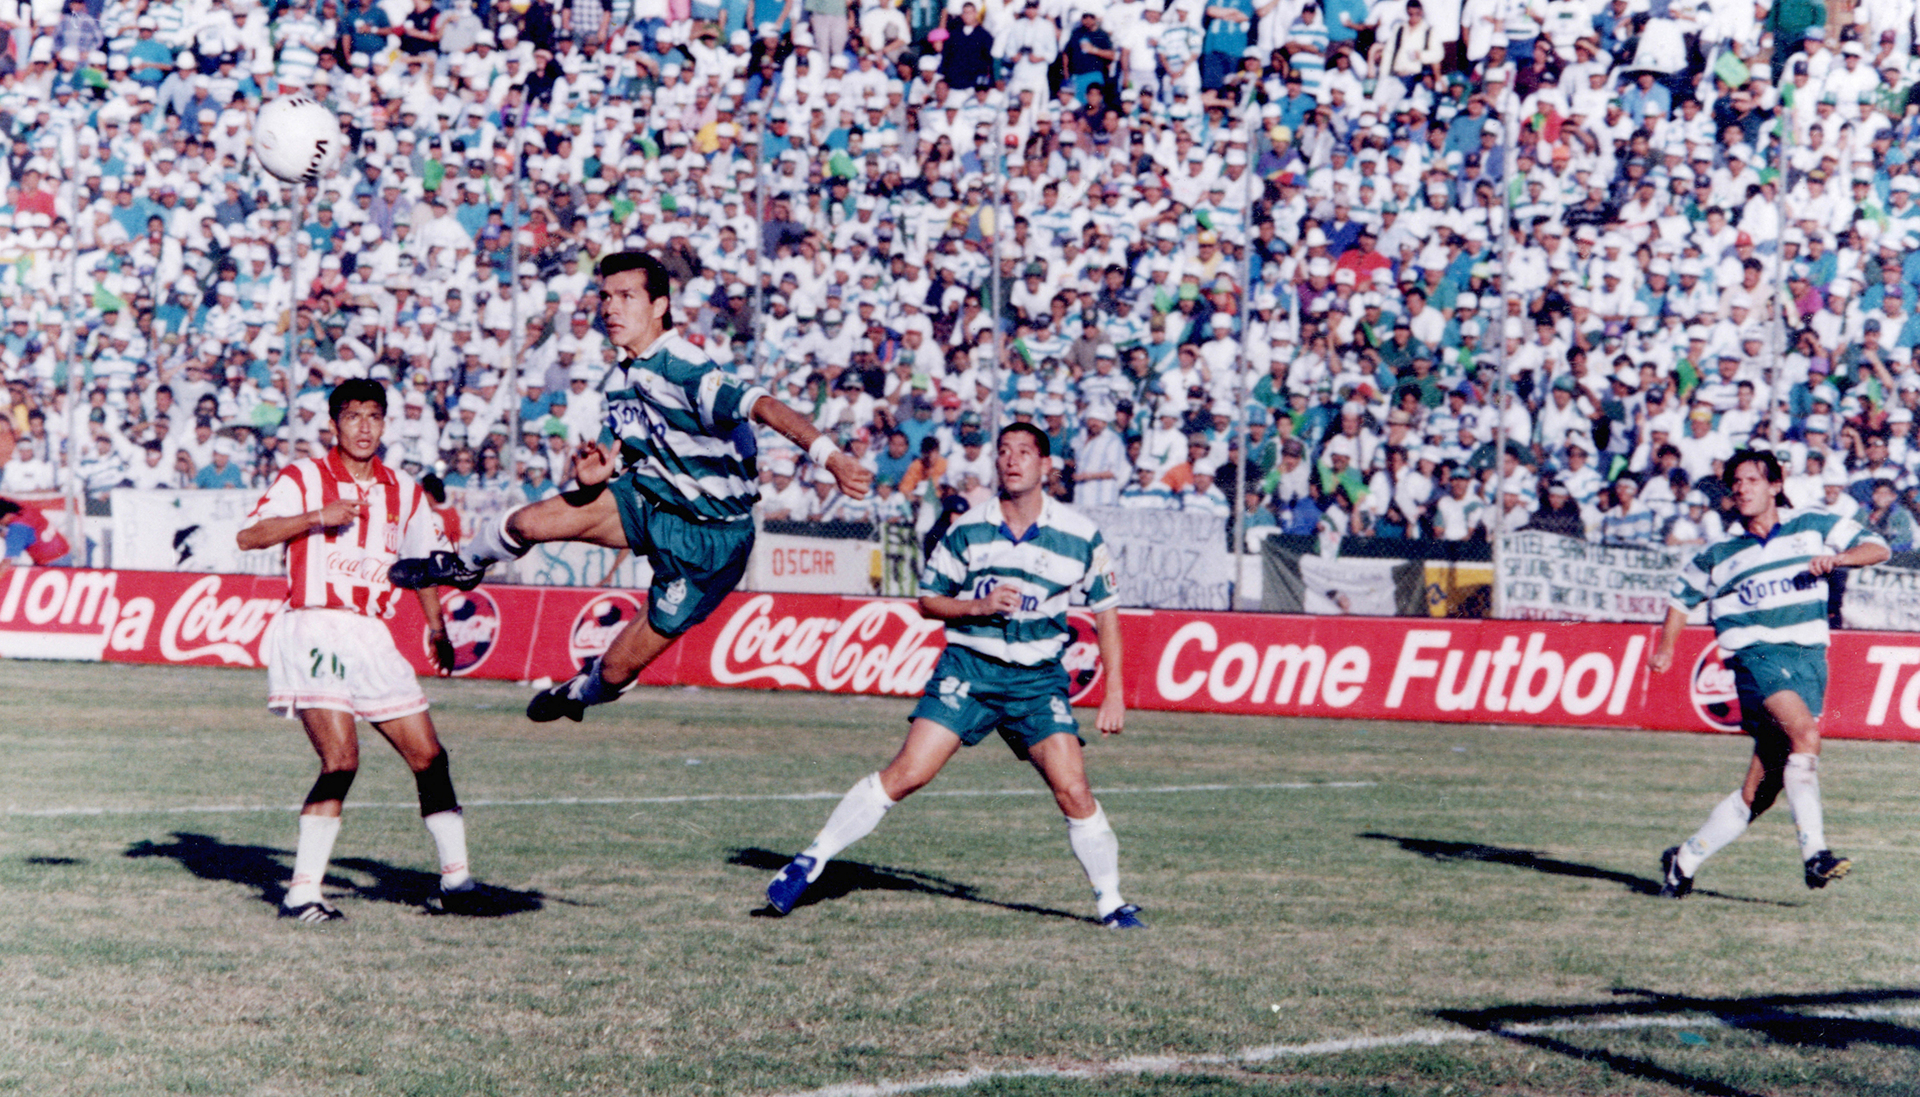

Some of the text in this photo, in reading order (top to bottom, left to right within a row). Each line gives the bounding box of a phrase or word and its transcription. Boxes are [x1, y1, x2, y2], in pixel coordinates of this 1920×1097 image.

[773, 548, 836, 577] OSCAR
[710, 594, 947, 695] Coca-Cola
[1156, 621, 1646, 718] Come Futbol
